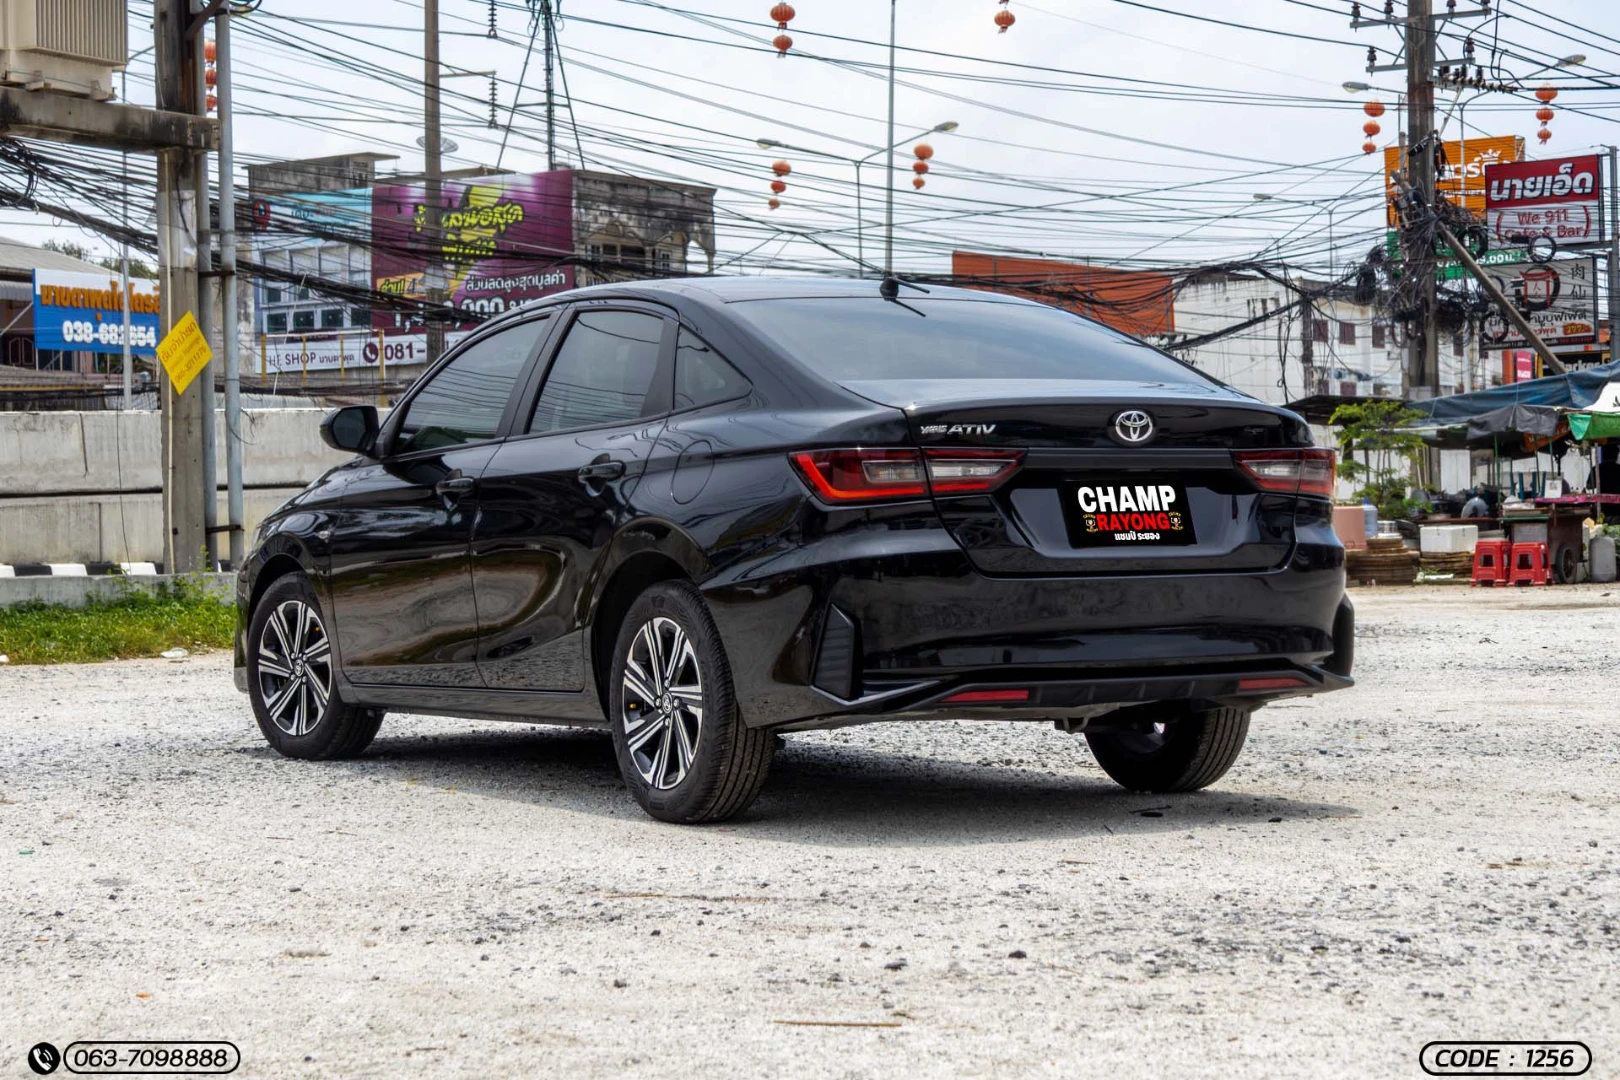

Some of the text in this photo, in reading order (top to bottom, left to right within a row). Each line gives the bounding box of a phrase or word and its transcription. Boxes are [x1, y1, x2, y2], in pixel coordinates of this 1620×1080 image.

[1490, 163, 1594, 201] นายเอ็ด
[1517, 209, 1569, 225] We 911
[1557, 224, 1583, 238] Bar
[285, 351, 316, 365] SHOP
[946, 424, 997, 435] ATIV
